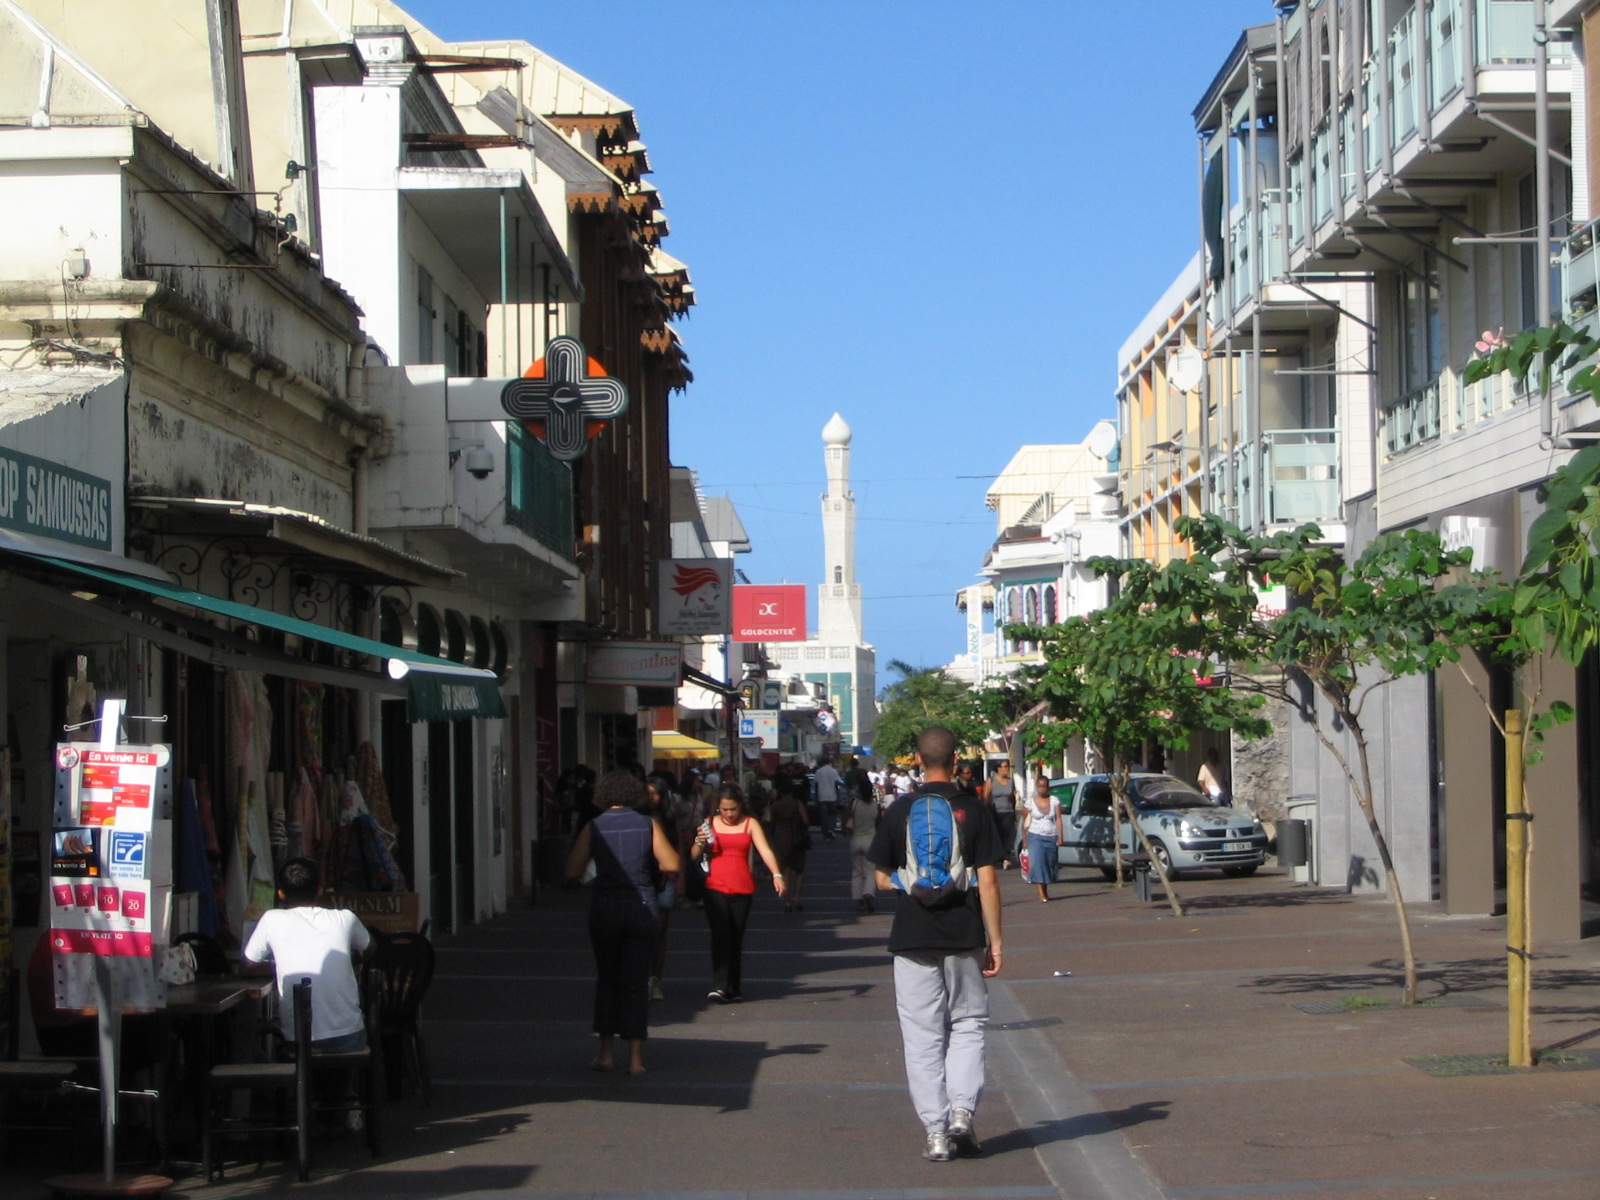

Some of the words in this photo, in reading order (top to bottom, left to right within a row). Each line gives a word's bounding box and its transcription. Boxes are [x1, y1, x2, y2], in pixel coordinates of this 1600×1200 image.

[26, 465, 108, 542] SAMOUSSAS
[740, 628, 795, 636] GOLDCENTER
[89, 752, 101, 761] En
[104, 753, 133, 763] vente
[136, 753, 149, 763] ici
[102, 896, 114, 904] 10
[330, 895, 401, 913] MAGNUM
[128, 901, 140, 910] 20
